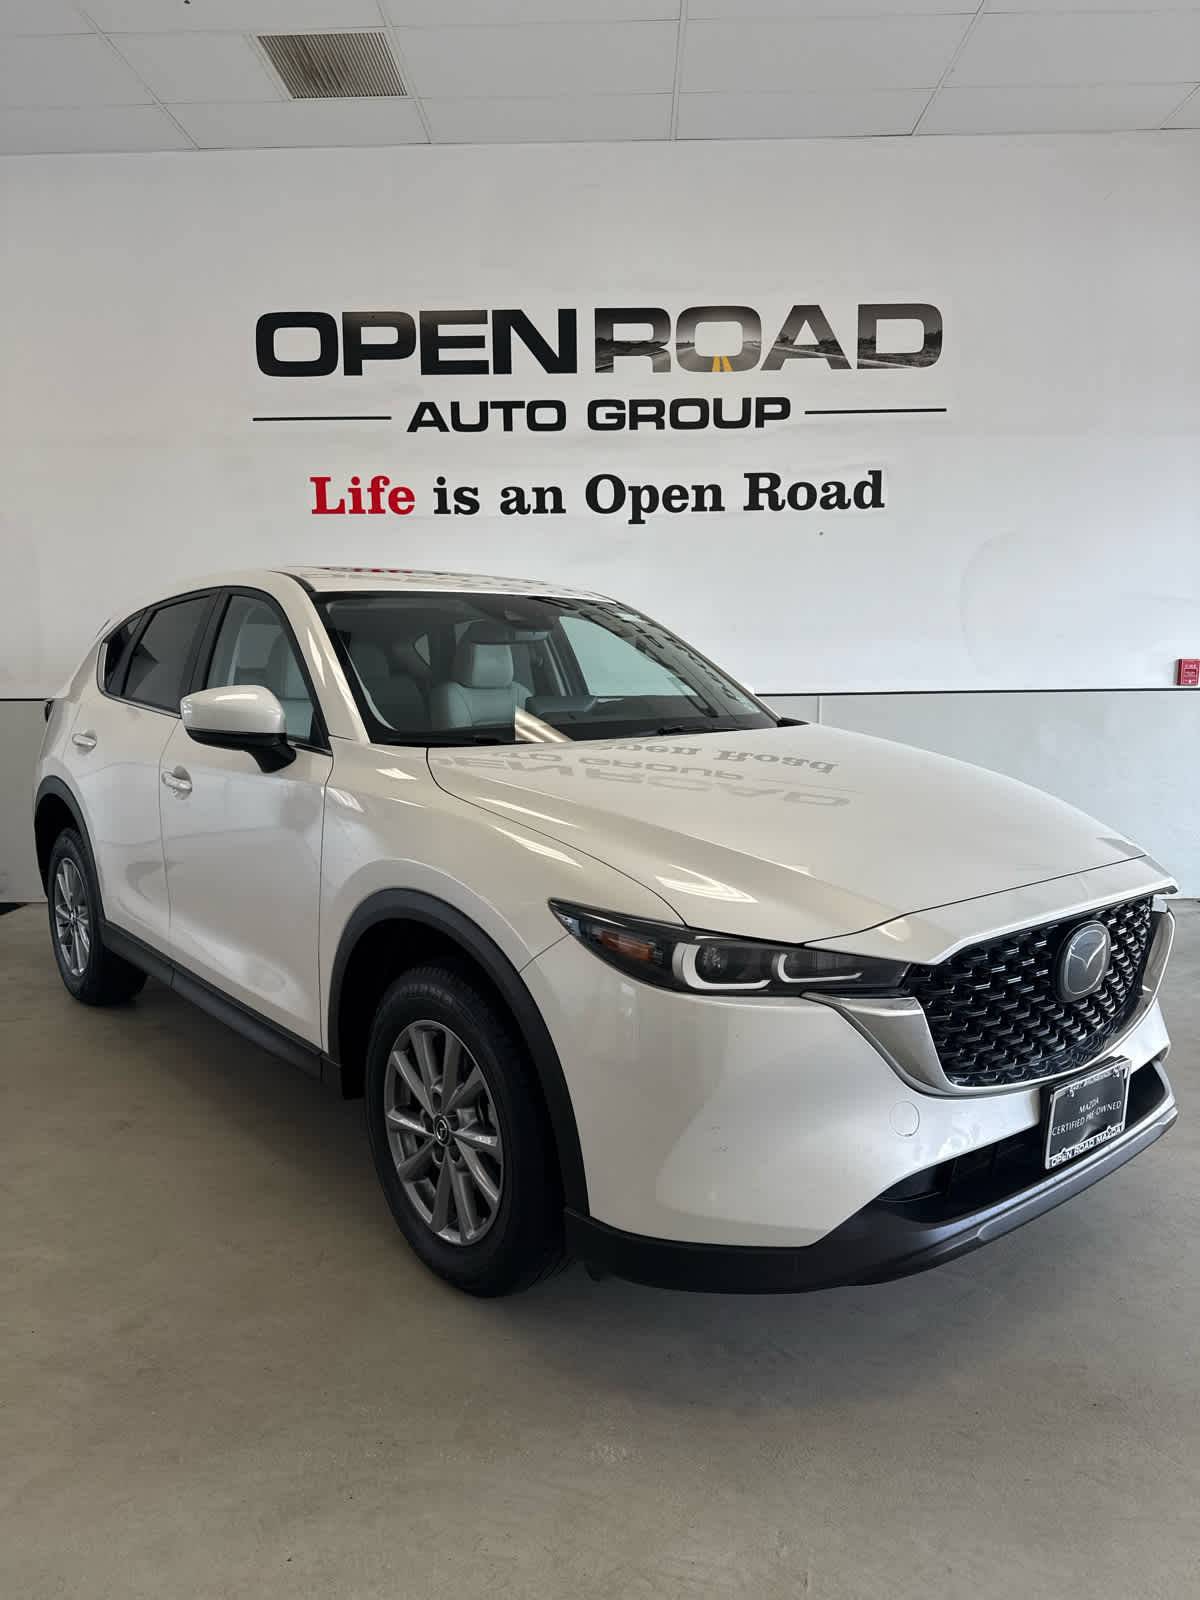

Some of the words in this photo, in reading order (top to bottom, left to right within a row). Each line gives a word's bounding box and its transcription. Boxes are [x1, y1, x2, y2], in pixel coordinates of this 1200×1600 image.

[256, 310, 578, 377] OPEN
[594, 303, 944, 374] ROAD
[407, 400, 567, 433] AUTO
[588, 397, 792, 431] GROUP
[310, 476, 416, 516] Life
[433, 477, 481, 516] is
[500, 486, 567, 516] an
[586, 474, 726, 525] Open
[743, 470, 886, 512] Road
[1052, 1116, 1085, 1136] CERTIFIED
[1051, 1149, 1072, 1167] OPEN
[1074, 1140, 1095, 1156] ROAD
